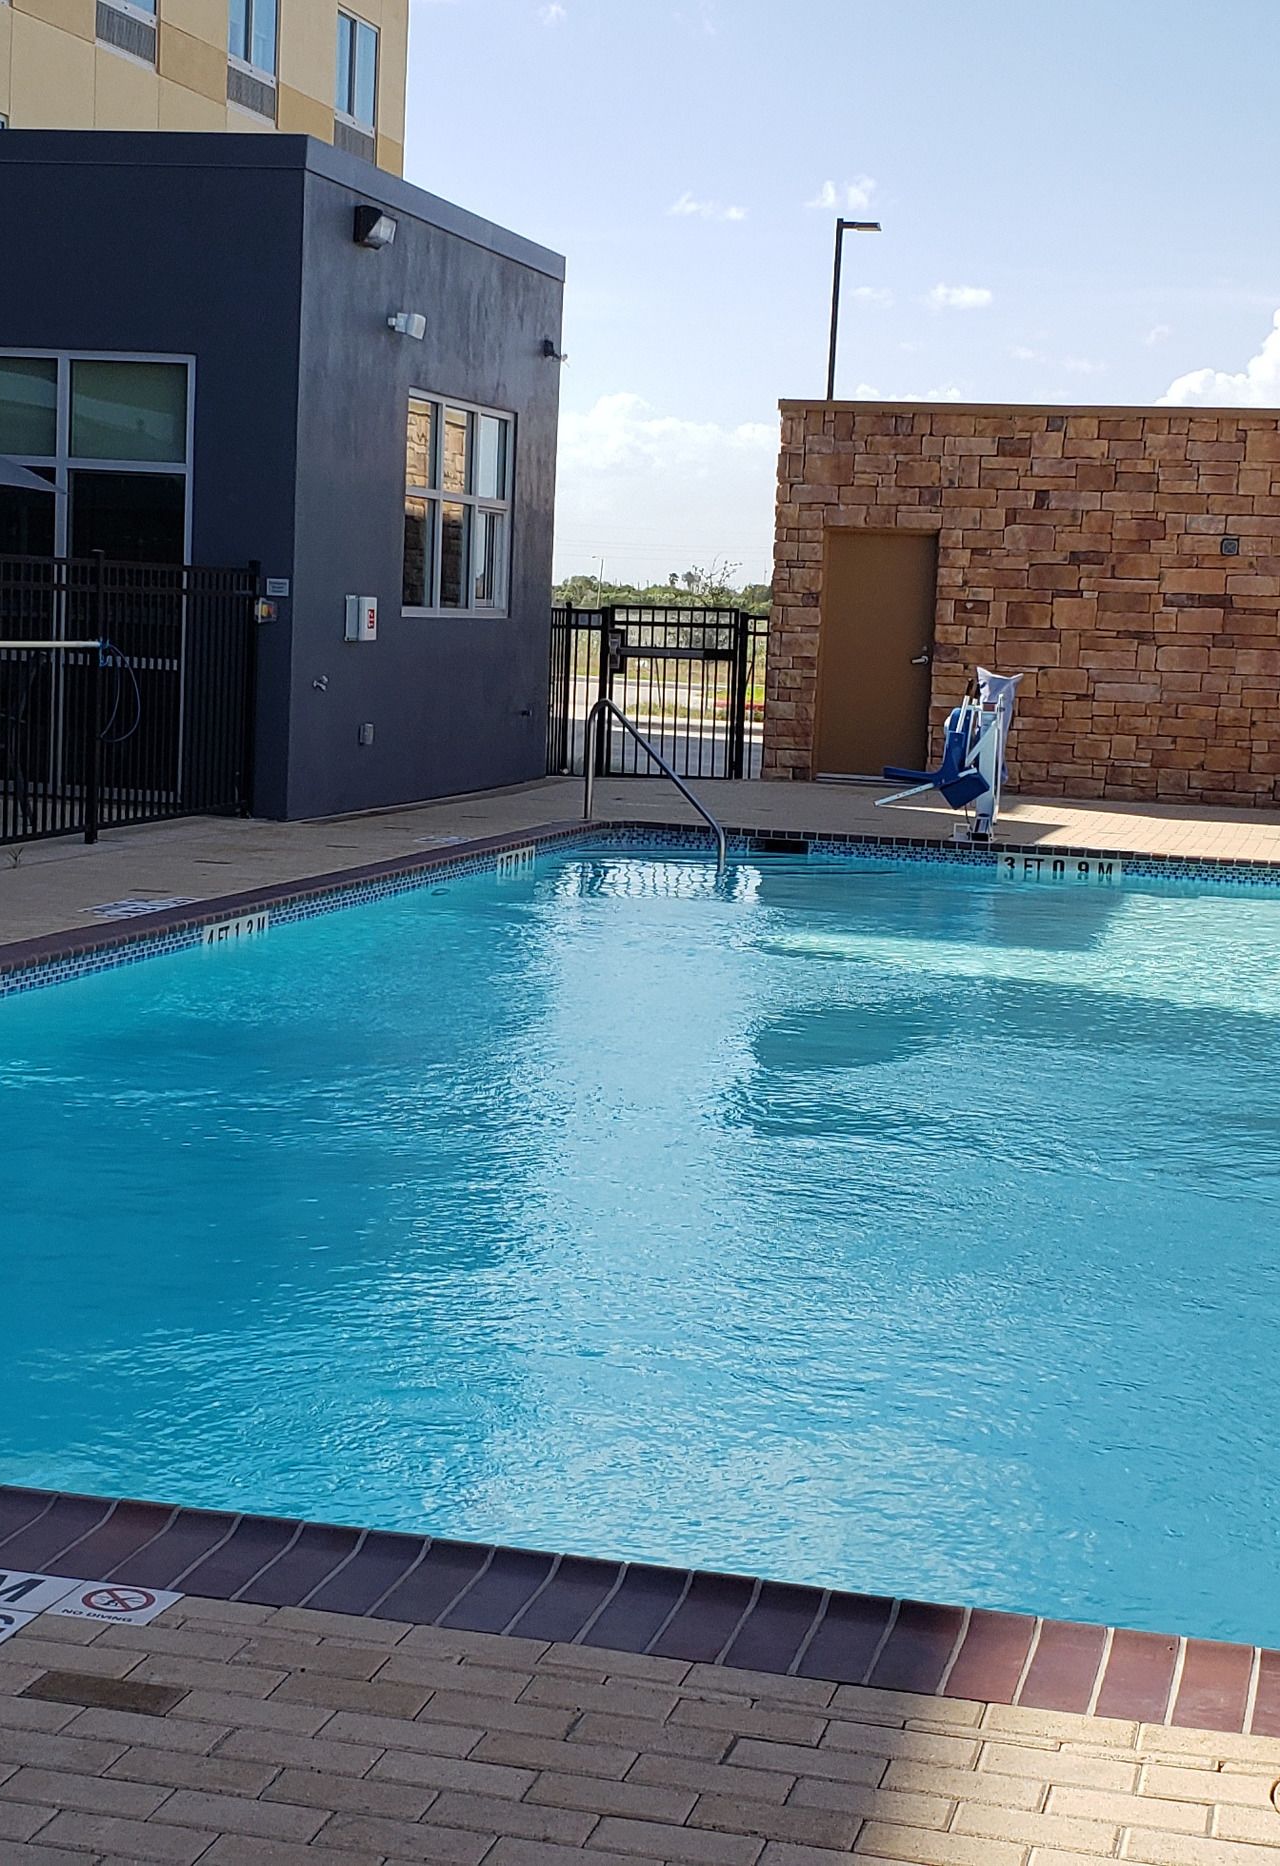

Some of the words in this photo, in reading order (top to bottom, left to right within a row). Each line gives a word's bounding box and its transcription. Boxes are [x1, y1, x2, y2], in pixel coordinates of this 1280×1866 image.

[1024, 858, 1045, 872] FT
[1098, 862, 1113, 876] M
[217, 926, 230, 941] FT
[61, 1608, 84, 1617] NO
[86, 1611, 133, 1623] DIVING
